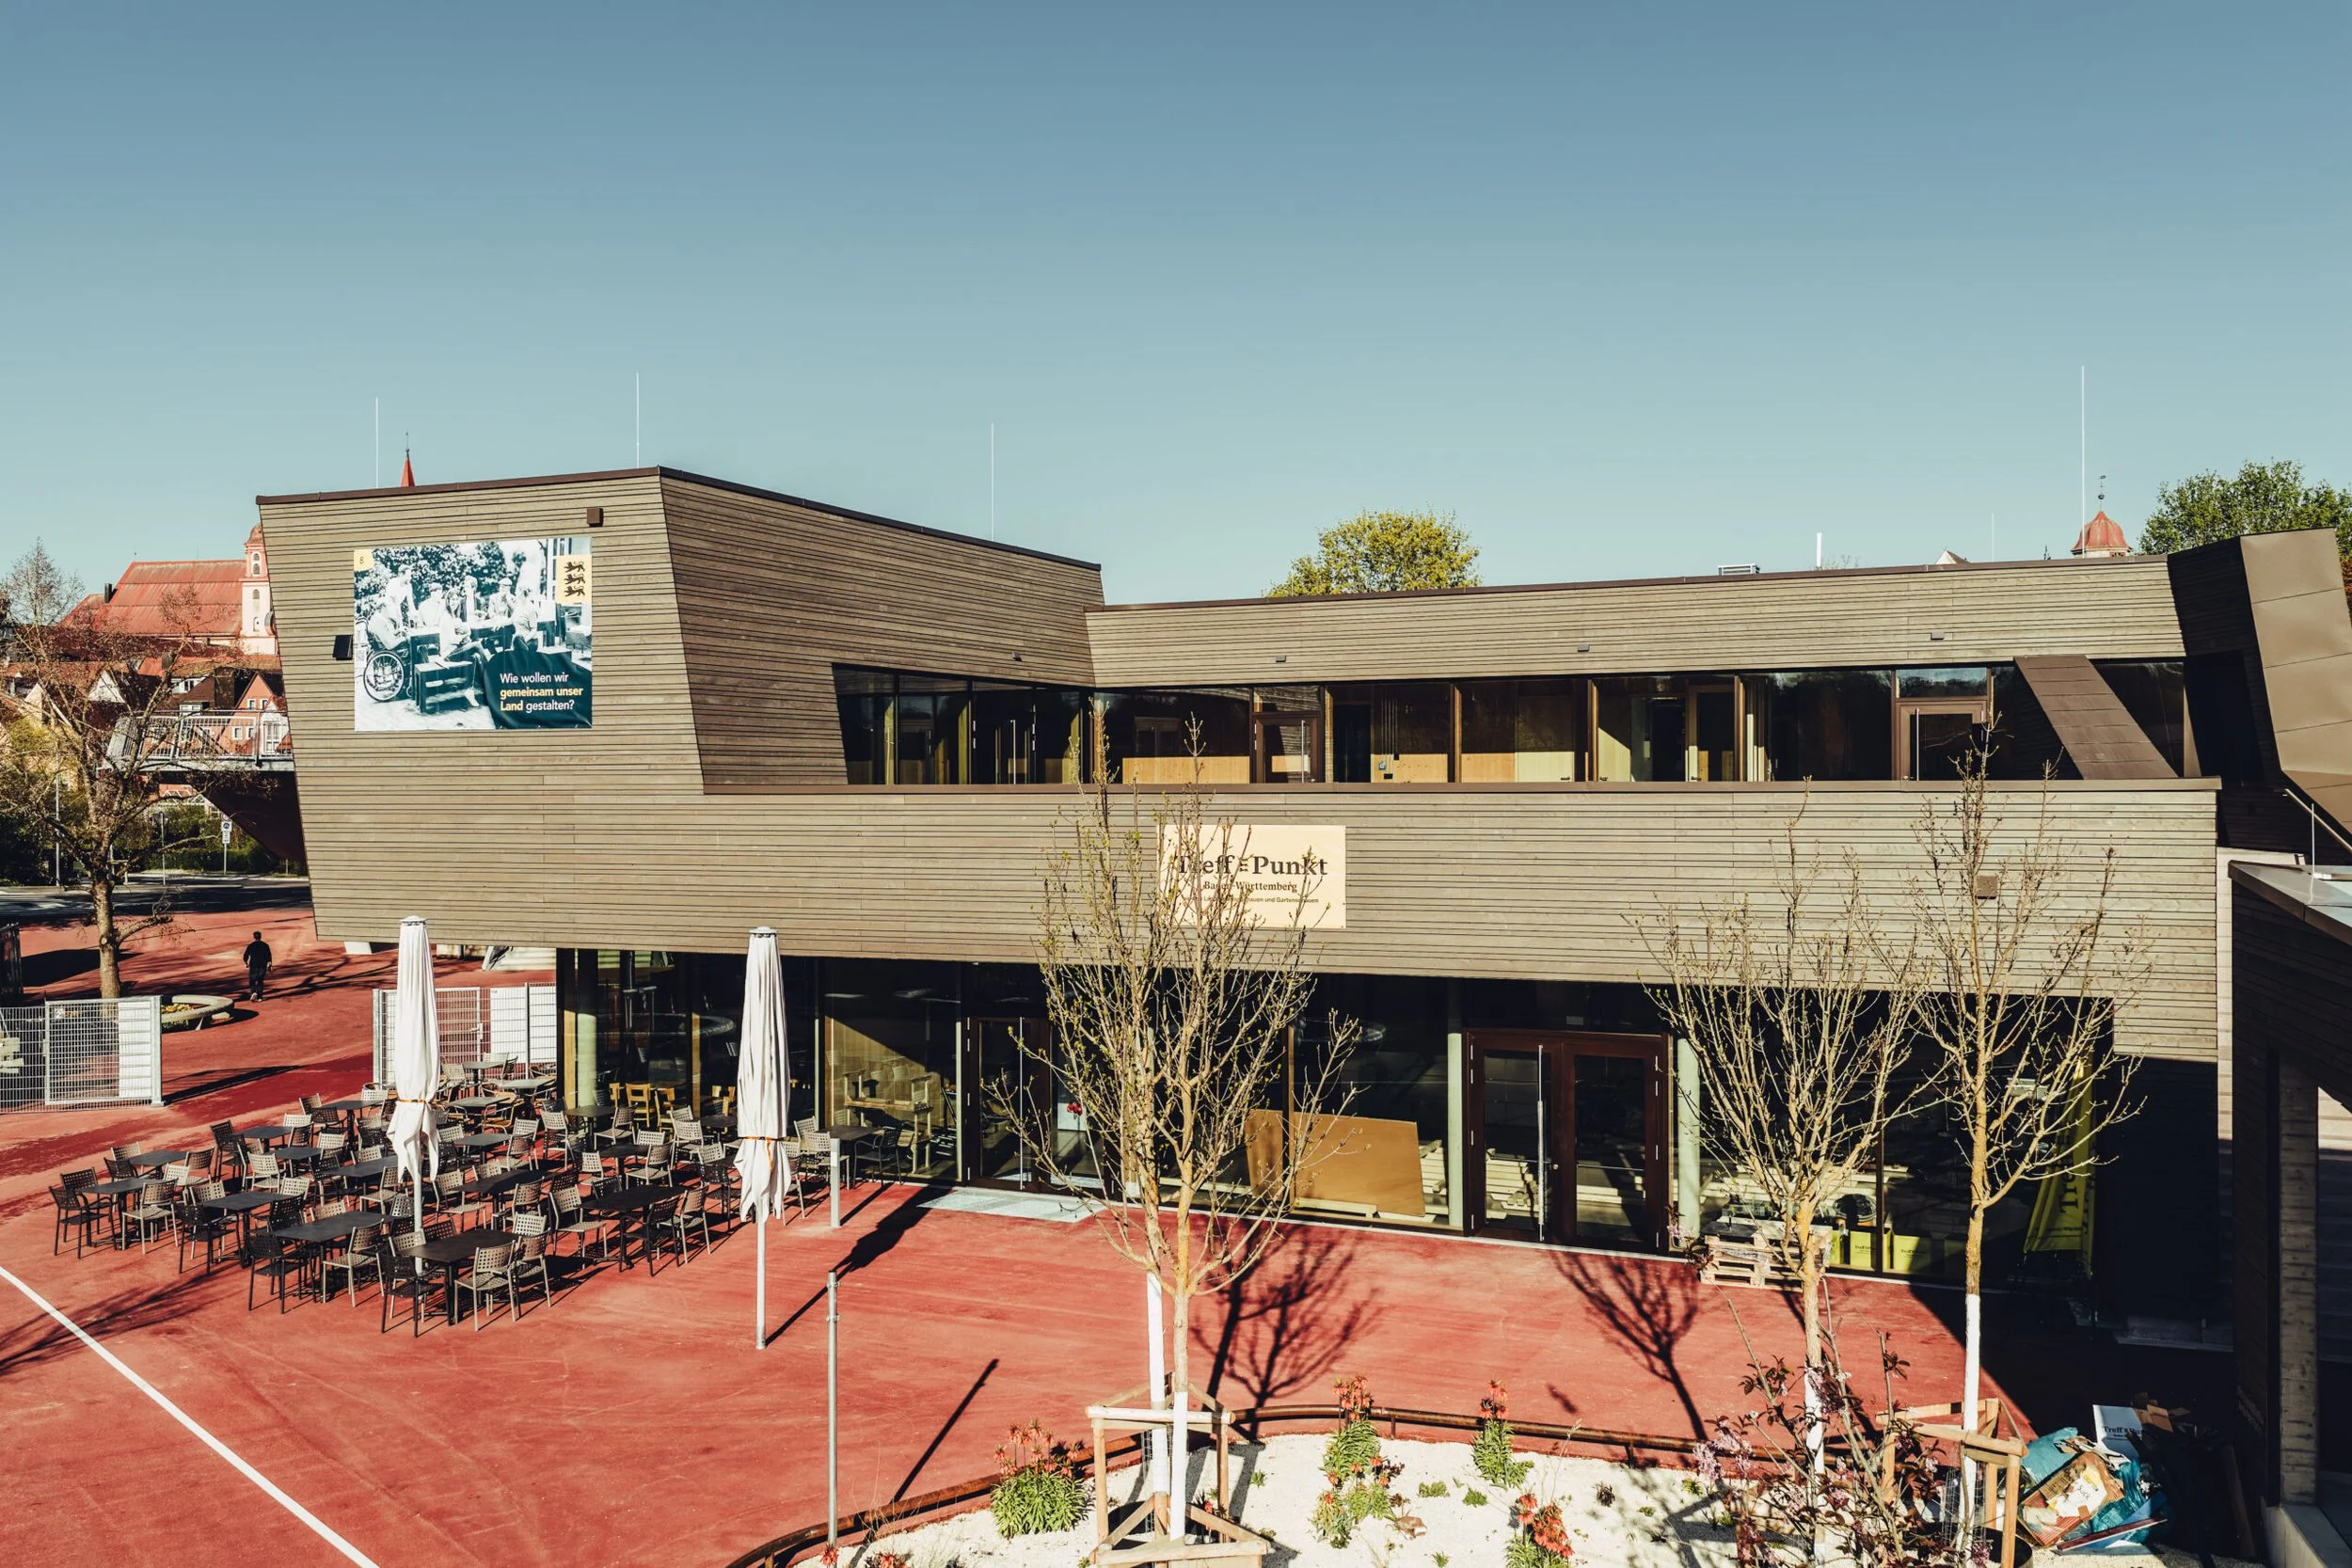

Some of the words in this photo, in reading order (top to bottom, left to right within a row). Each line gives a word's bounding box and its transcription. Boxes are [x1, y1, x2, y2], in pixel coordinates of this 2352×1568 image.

[500, 673, 518, 683] Wie
[521, 672, 551, 683] wollen
[554, 672, 569, 682] wir
[500, 687, 553, 700] gemeinsam
[556, 688, 583, 696] unser
[501, 700, 523, 711] Land
[526, 699, 575, 713] gestalten?
[1175, 855, 1235, 875] Teff
[1252, 854, 1328, 876] Punkt
